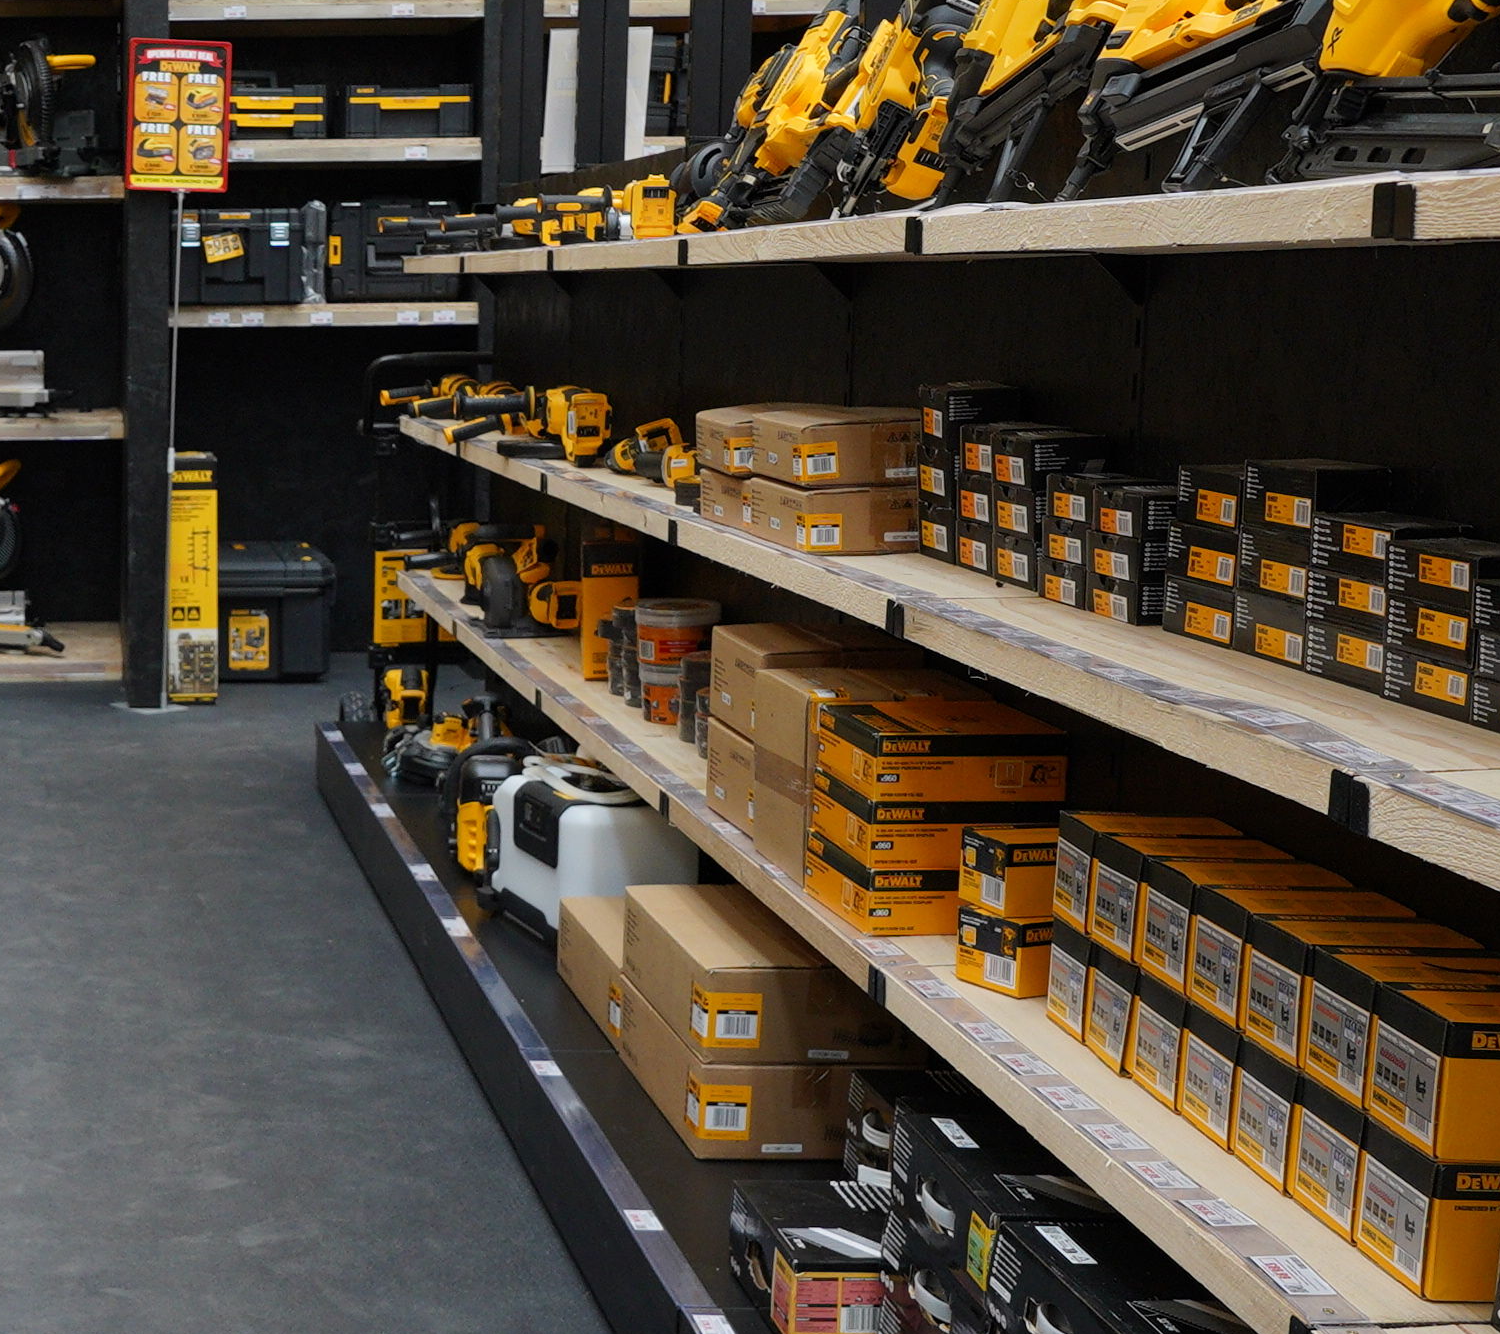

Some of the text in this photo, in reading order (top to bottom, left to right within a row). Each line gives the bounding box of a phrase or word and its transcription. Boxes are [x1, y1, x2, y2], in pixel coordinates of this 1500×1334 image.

[142, 72, 172, 82] FREE
[188, 74, 218, 84] FREE
[140, 123, 170, 134] FREE
[187, 125, 217, 135] FREE
